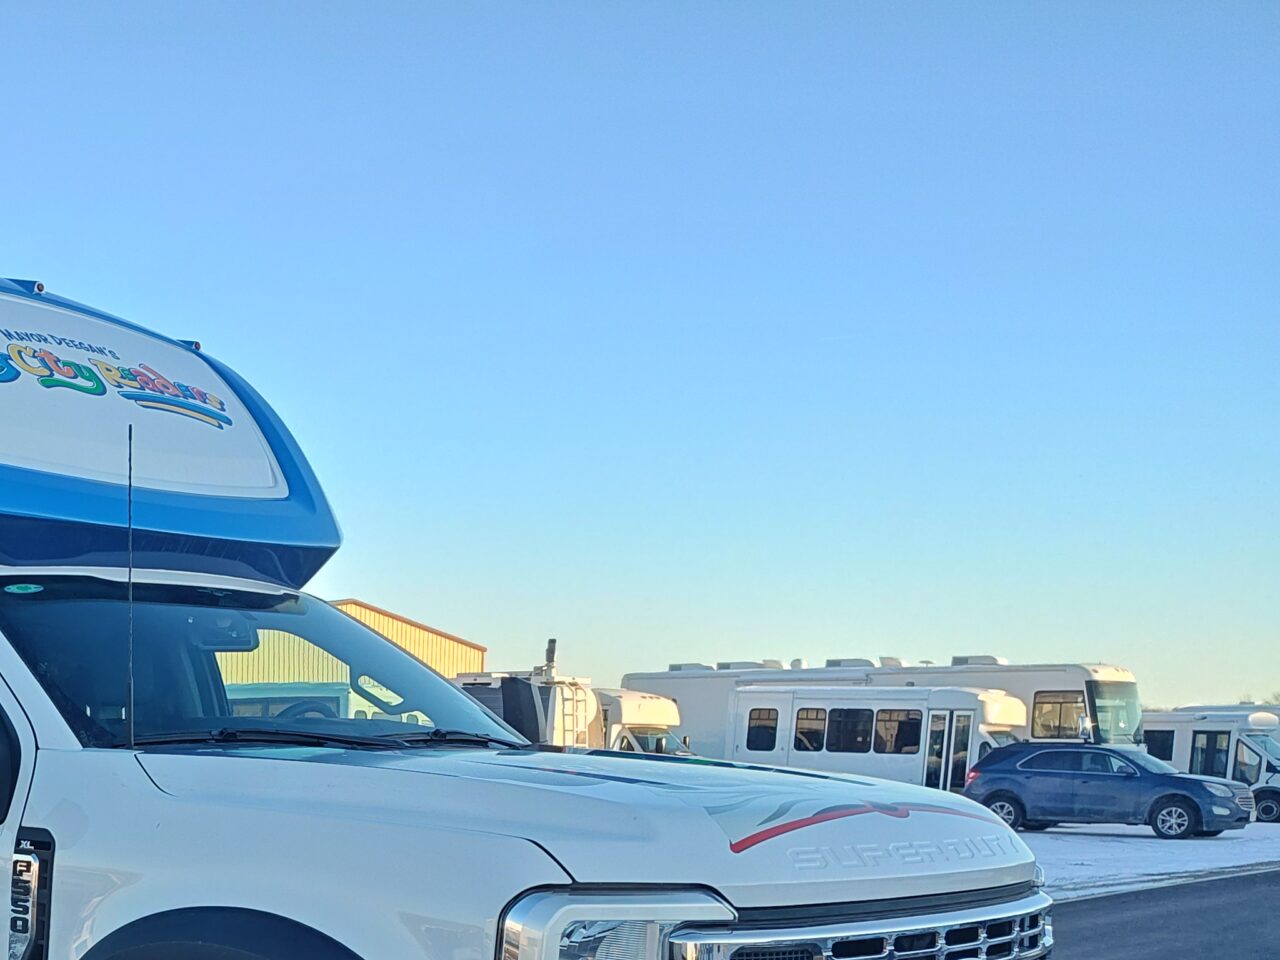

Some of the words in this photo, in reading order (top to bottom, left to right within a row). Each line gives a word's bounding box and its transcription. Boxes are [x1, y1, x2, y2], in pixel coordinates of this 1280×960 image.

[0, 328, 52, 345] MAYOR
[49, 333, 121, 361] DEEGAN'S
[88, 358, 227, 412] Readers
[19, 840, 35, 850] XL
